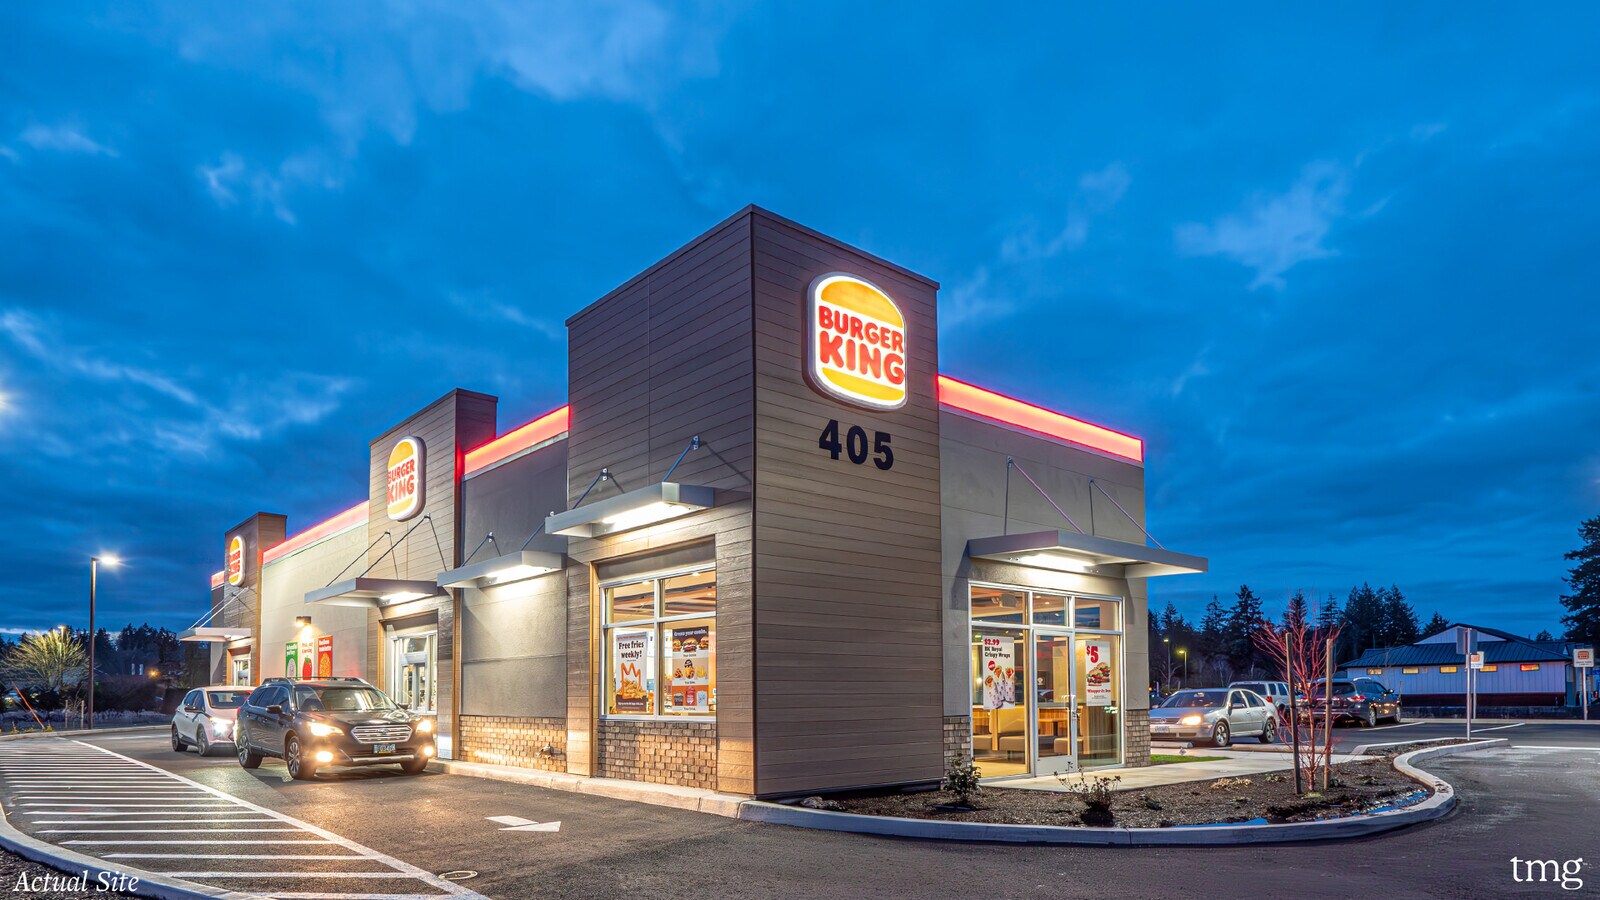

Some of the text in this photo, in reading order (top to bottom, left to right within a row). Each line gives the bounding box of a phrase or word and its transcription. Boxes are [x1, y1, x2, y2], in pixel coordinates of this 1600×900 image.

[818, 305, 904, 354] BURGER
[819, 330, 905, 385] KING
[818, 419, 894, 470] 405
[387, 459, 415, 484] BURGER
[386, 475, 415, 504] KING
[618, 640, 644, 650] Free fries
[621, 650, 642, 659] weekly!
[1086, 645, 1099, 663] $5
